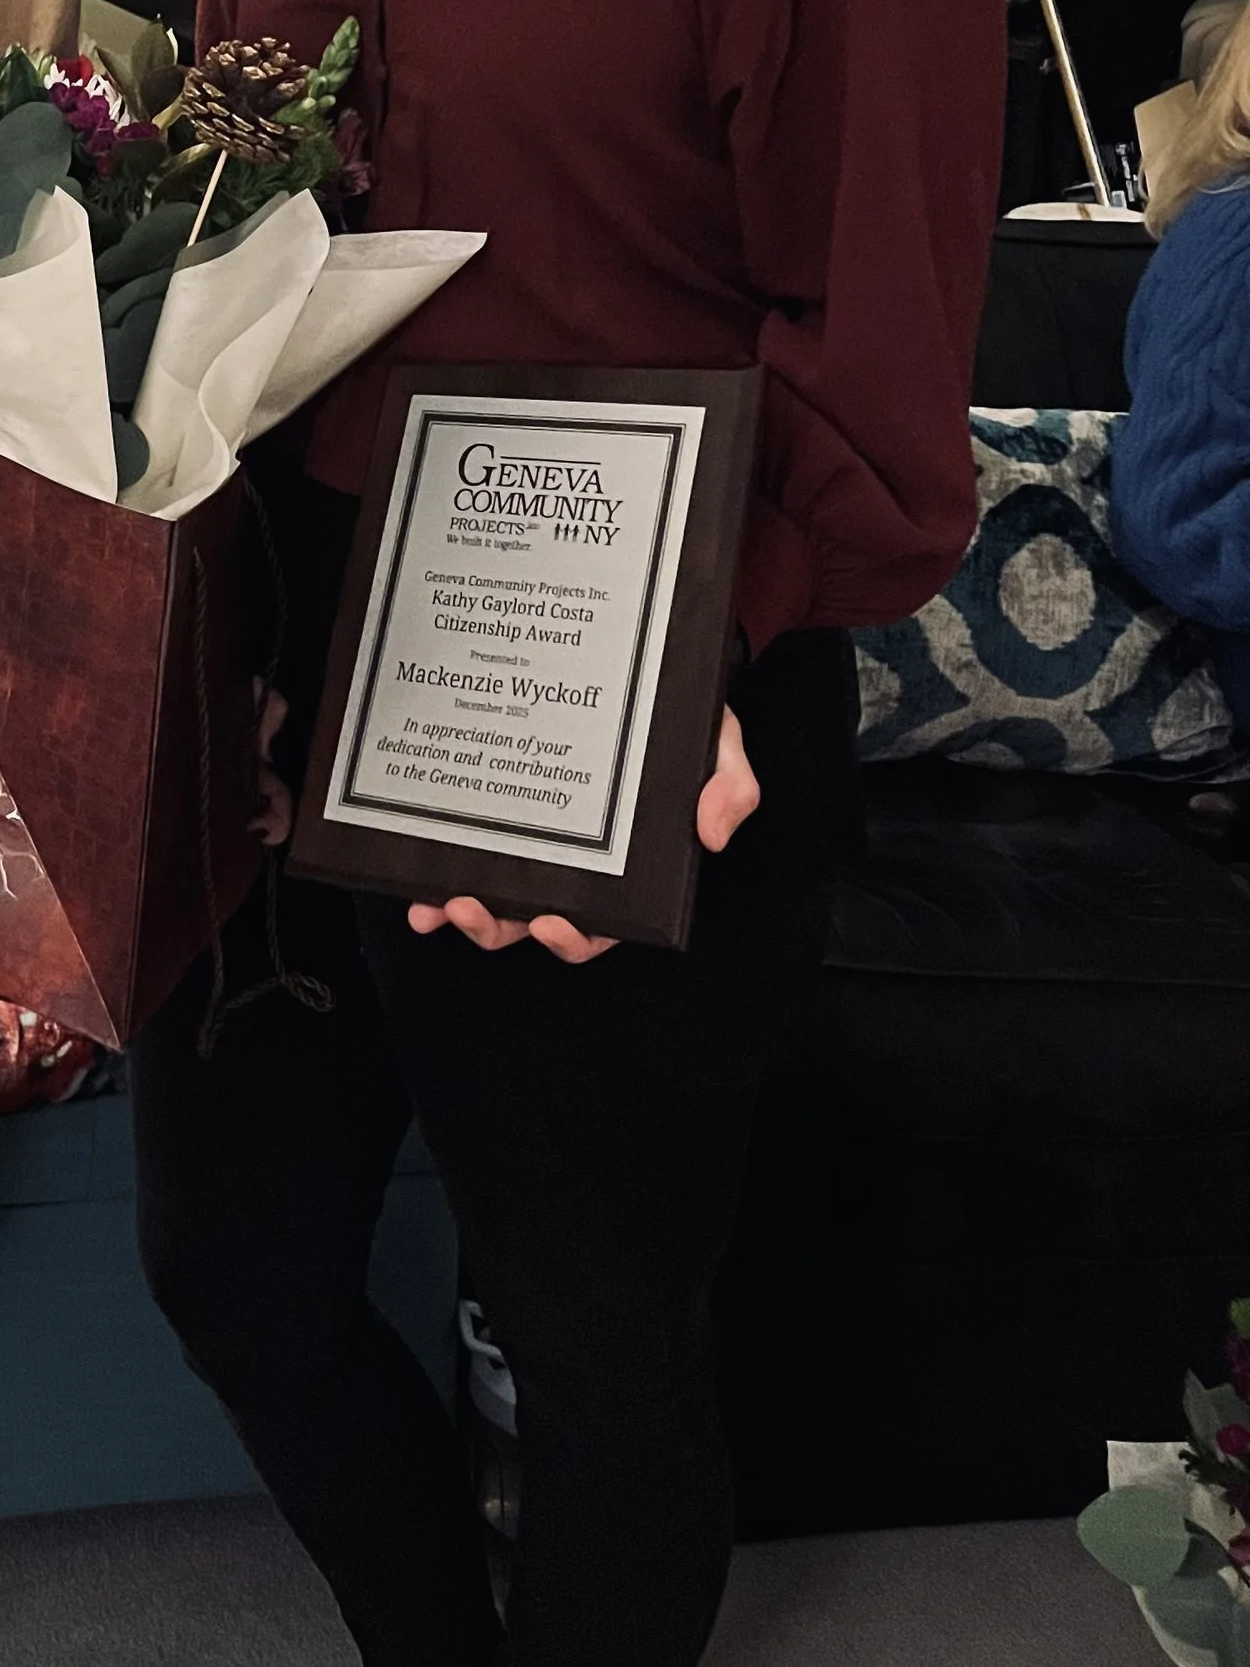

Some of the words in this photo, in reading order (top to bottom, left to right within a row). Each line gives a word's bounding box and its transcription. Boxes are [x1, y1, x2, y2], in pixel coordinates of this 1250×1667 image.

[458, 443, 604, 494] GENEVA
[453, 488, 623, 524] COMMUNITY
[450, 516, 525, 535] PROJECTS
[583, 525, 620, 546] NY
[424, 570, 465, 586] Geneva
[468, 575, 537, 596] Community
[538, 582, 586, 598] Projects
[588, 587, 610, 601] Inc.
[432, 590, 478, 613] Kathy
[482, 595, 546, 617] Gaylord
[550, 603, 594, 622] Costa
[434, 614, 522, 643] Citizenship
[525, 625, 582, 646] Award
[470, 649, 517, 666] Presented
[396, 661, 503, 694] Mackenzie
[511, 676, 602, 708] Wyckoff
[454, 698, 504, 715] December
[403, 717, 418, 733] In
[422, 721, 513, 748] appreciation
[517, 735, 536, 756] of
[531, 740, 572, 757] your
[377, 736, 450, 763] dedication
[453, 750, 483, 767] and
[489, 755, 592, 785] contributions
[385, 762, 400, 776] to
[403, 764, 426, 782] the
[429, 768, 483, 791] Geneva
[486, 781, 572, 810] community
